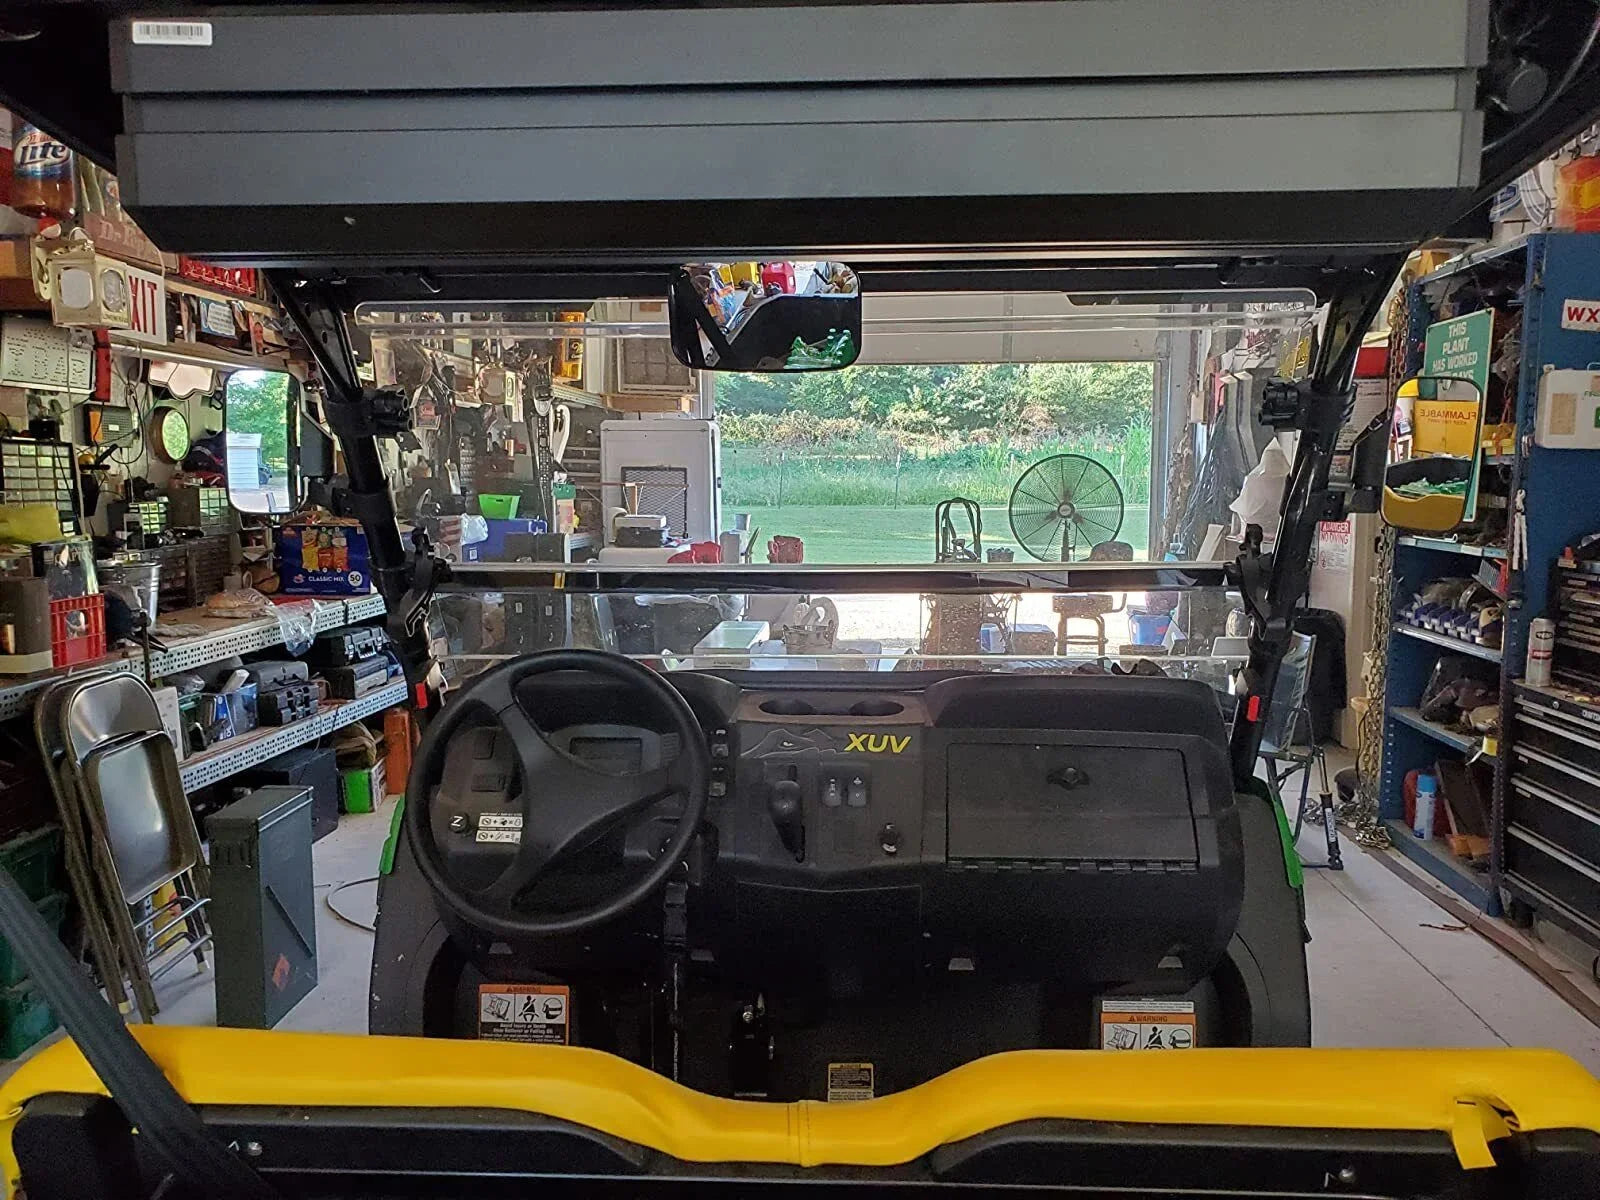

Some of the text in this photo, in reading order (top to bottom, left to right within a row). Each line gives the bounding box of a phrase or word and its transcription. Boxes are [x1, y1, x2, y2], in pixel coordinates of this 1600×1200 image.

[19, 142, 66, 169] Lite
[129, 275, 157, 336] XIT
[1448, 321, 1467, 339] THIS
[1442, 337, 1470, 355] PLANT
[1432, 352, 1478, 373] HAS WORKED
[1453, 370, 1474, 380] DAYS
[1326, 522, 1349, 533] DANGER
[1321, 532, 1349, 544] NO DIVING
[350, 574, 361, 582] 50
[844, 733, 912, 754] XUV
[1136, 1015, 1168, 1023] WARNING
